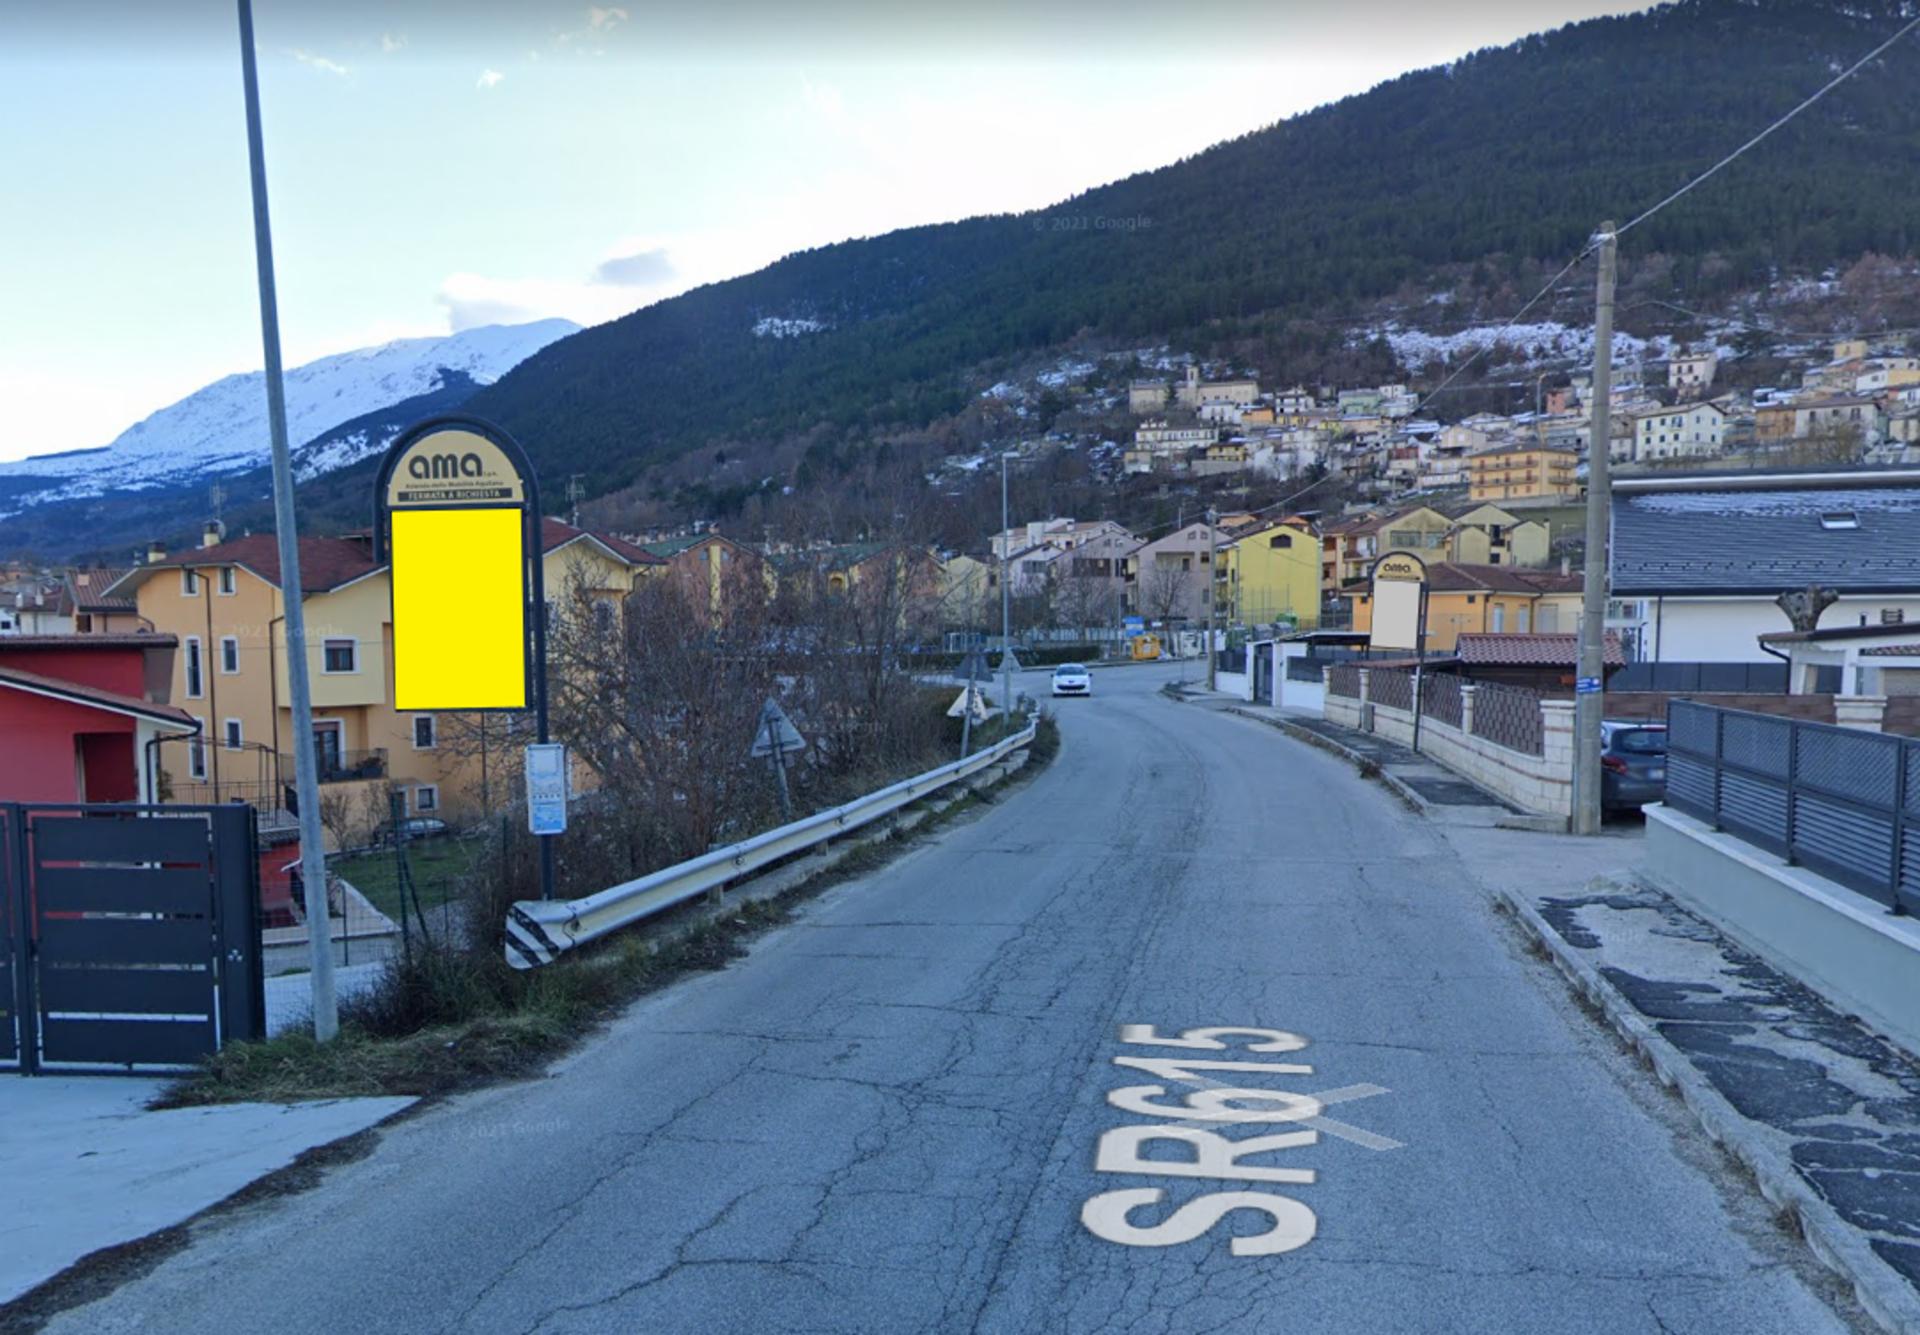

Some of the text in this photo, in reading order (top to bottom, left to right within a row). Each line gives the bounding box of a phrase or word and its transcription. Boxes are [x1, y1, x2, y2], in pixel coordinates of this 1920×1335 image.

[408, 453, 483, 479] ama
[408, 491, 446, 500] FERMATA
[456, 489, 500, 499] RICHIESTA
